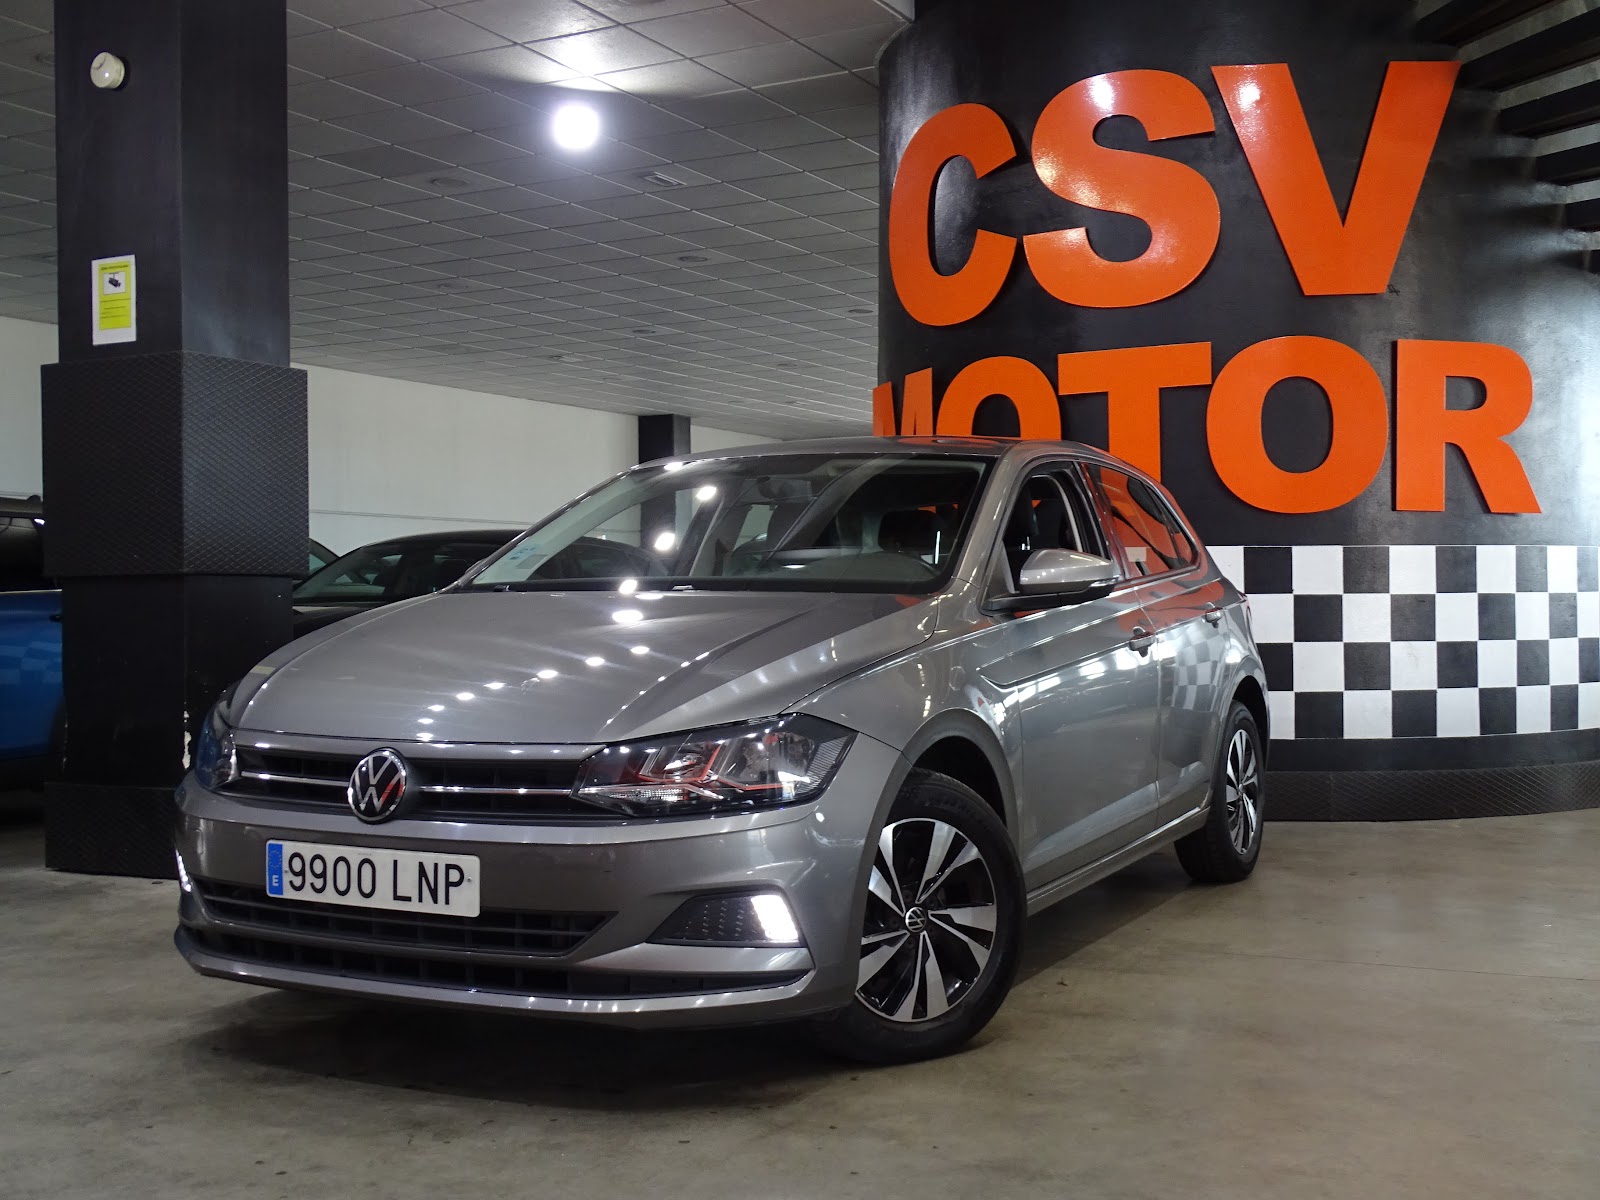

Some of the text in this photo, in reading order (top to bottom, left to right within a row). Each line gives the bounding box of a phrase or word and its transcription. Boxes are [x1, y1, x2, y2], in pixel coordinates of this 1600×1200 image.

[888, 60, 1460, 327] CSV
[271, 874, 280, 887] E
[288, 852, 465, 906] 9900 LNP
